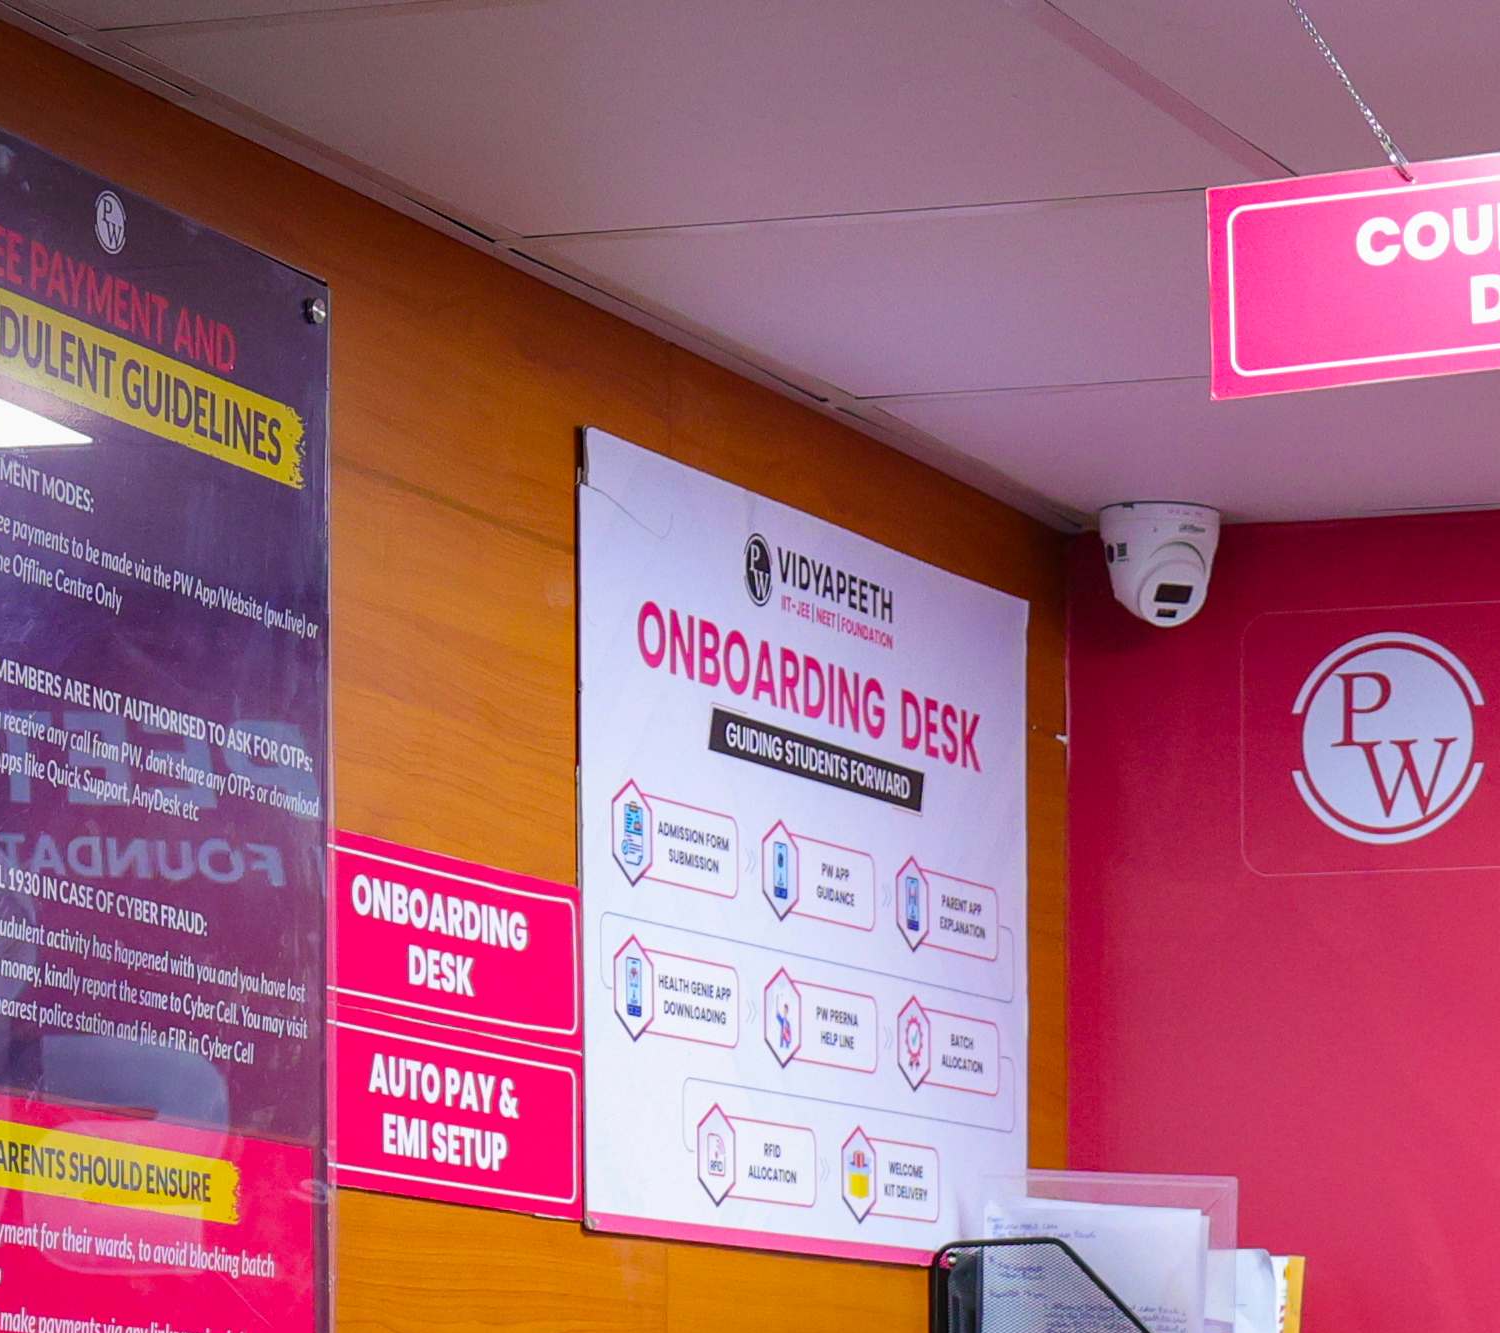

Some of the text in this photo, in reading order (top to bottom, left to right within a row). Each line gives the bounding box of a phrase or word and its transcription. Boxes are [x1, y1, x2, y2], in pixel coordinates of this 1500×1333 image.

[31, 240, 169, 345] PAYMENT
[174, 309, 237, 372] AND
[122, 359, 282, 466] GUIDELINES
[42, 474, 94, 513] MODES:
[12, 519, 70, 555] payments
[71, 536, 84, 560] to
[85, 538, 100, 565] be
[101, 551, 133, 577] made
[134, 558, 151, 583] via
[153, 564, 172, 590] the
[172, 569, 194, 597] PW
[194, 578, 263, 621] App/Website
[263, 601, 306, 639] (pw.live)
[306, 622, 319, 640] or
[12, 554, 53, 588] Offline
[55, 568, 93, 602] Centre
[95, 581, 123, 616] Only
[777, 546, 893, 624] VIDYAPEETH
[816, 607, 836, 629] NEET
[841, 617, 894, 650] FOUNDATION
[637, 601, 983, 773] ONBOARDING DESK
[63, 678, 91, 707] ARE
[92, 686, 122, 717] NOT
[123, 696, 206, 741] AUTHORISED
[207, 720, 226, 747] TO
[226, 727, 252, 756] ASK
[254, 735, 279, 763] FOR
[279, 743, 313, 774] OTPs:
[725, 721, 911, 801] GUIDING STUDENTS FORWARD
[657, 821, 730, 851] ADMISSION FORM
[668, 848, 720, 874] SUBMISSION
[8, 867, 40, 897] 1930
[42, 875, 58, 902] IN
[59, 880, 94, 910] CASE
[95, 889, 115, 914] OF
[116, 894, 159, 926] CYBER
[160, 904, 208, 937] FRAUD:
[351, 874, 528, 951] ONBOARDING
[816, 885, 855, 907] GUIDANCE
[941, 895, 968, 913] PARENT
[939, 917, 986, 939] EXPLANATION
[408, 944, 475, 997] DESK
[658, 975, 732, 1000] HEALTH GENIE APP
[663, 1000, 727, 1025] DOWNLOADING
[820, 1031, 855, 1049] HELP LINE
[950, 1033, 974, 1049] BATCH
[941, 1055, 984, 1075] ALLOCATION
[369, 1053, 519, 1119] AUTO PAY &
[382, 1113, 508, 1171] EMI SETUP
[763, 1143, 781, 1158] RFID
[69, 1154, 142, 1192] SHOULD
[146, 1169, 211, 1202] ENSURE
[748, 1166, 797, 1184] ALLOCATION
[888, 1160, 924, 1179] WELCOME
[884, 1184, 928, 1202] KIT DELIVERY
